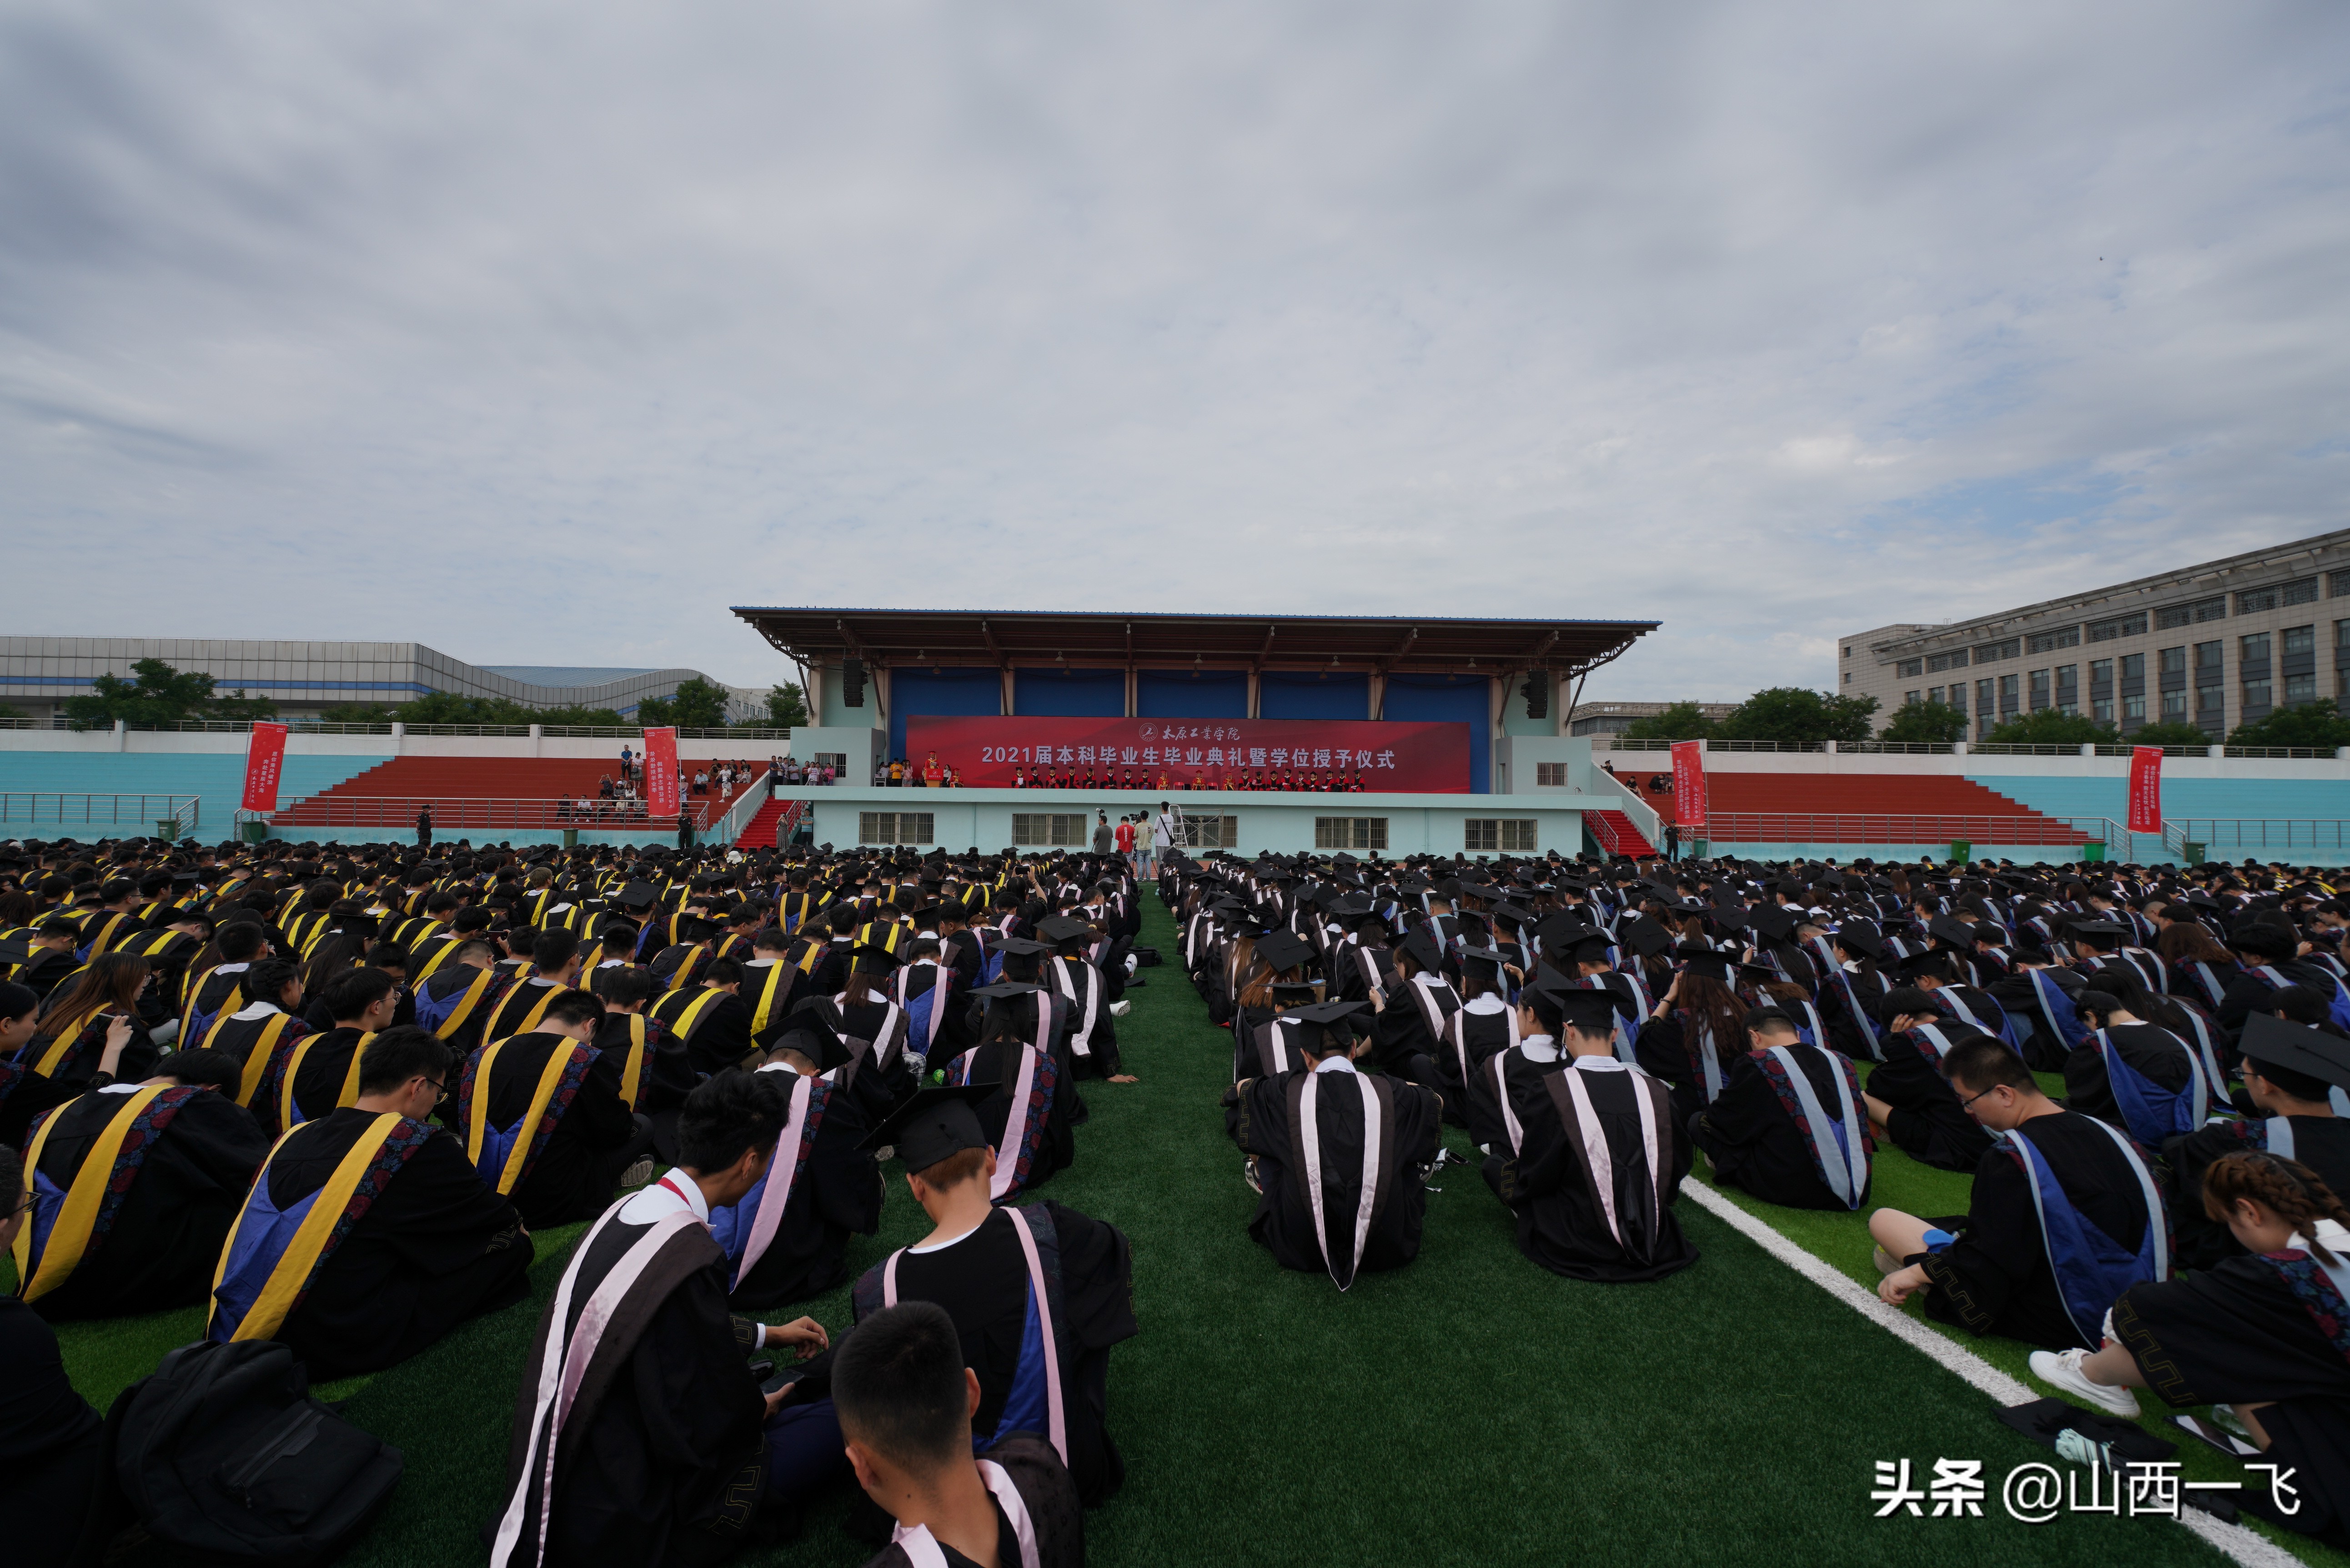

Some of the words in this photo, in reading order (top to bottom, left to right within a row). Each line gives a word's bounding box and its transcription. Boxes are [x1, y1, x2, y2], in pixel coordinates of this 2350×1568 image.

[266, 751, 278, 785] 愿你乘风破浪
[982, 745, 1396, 769] 2021届本科毕业生毕业典礼暨学位授予仪式
[258, 759, 269, 793] 奔赴星辰大海
